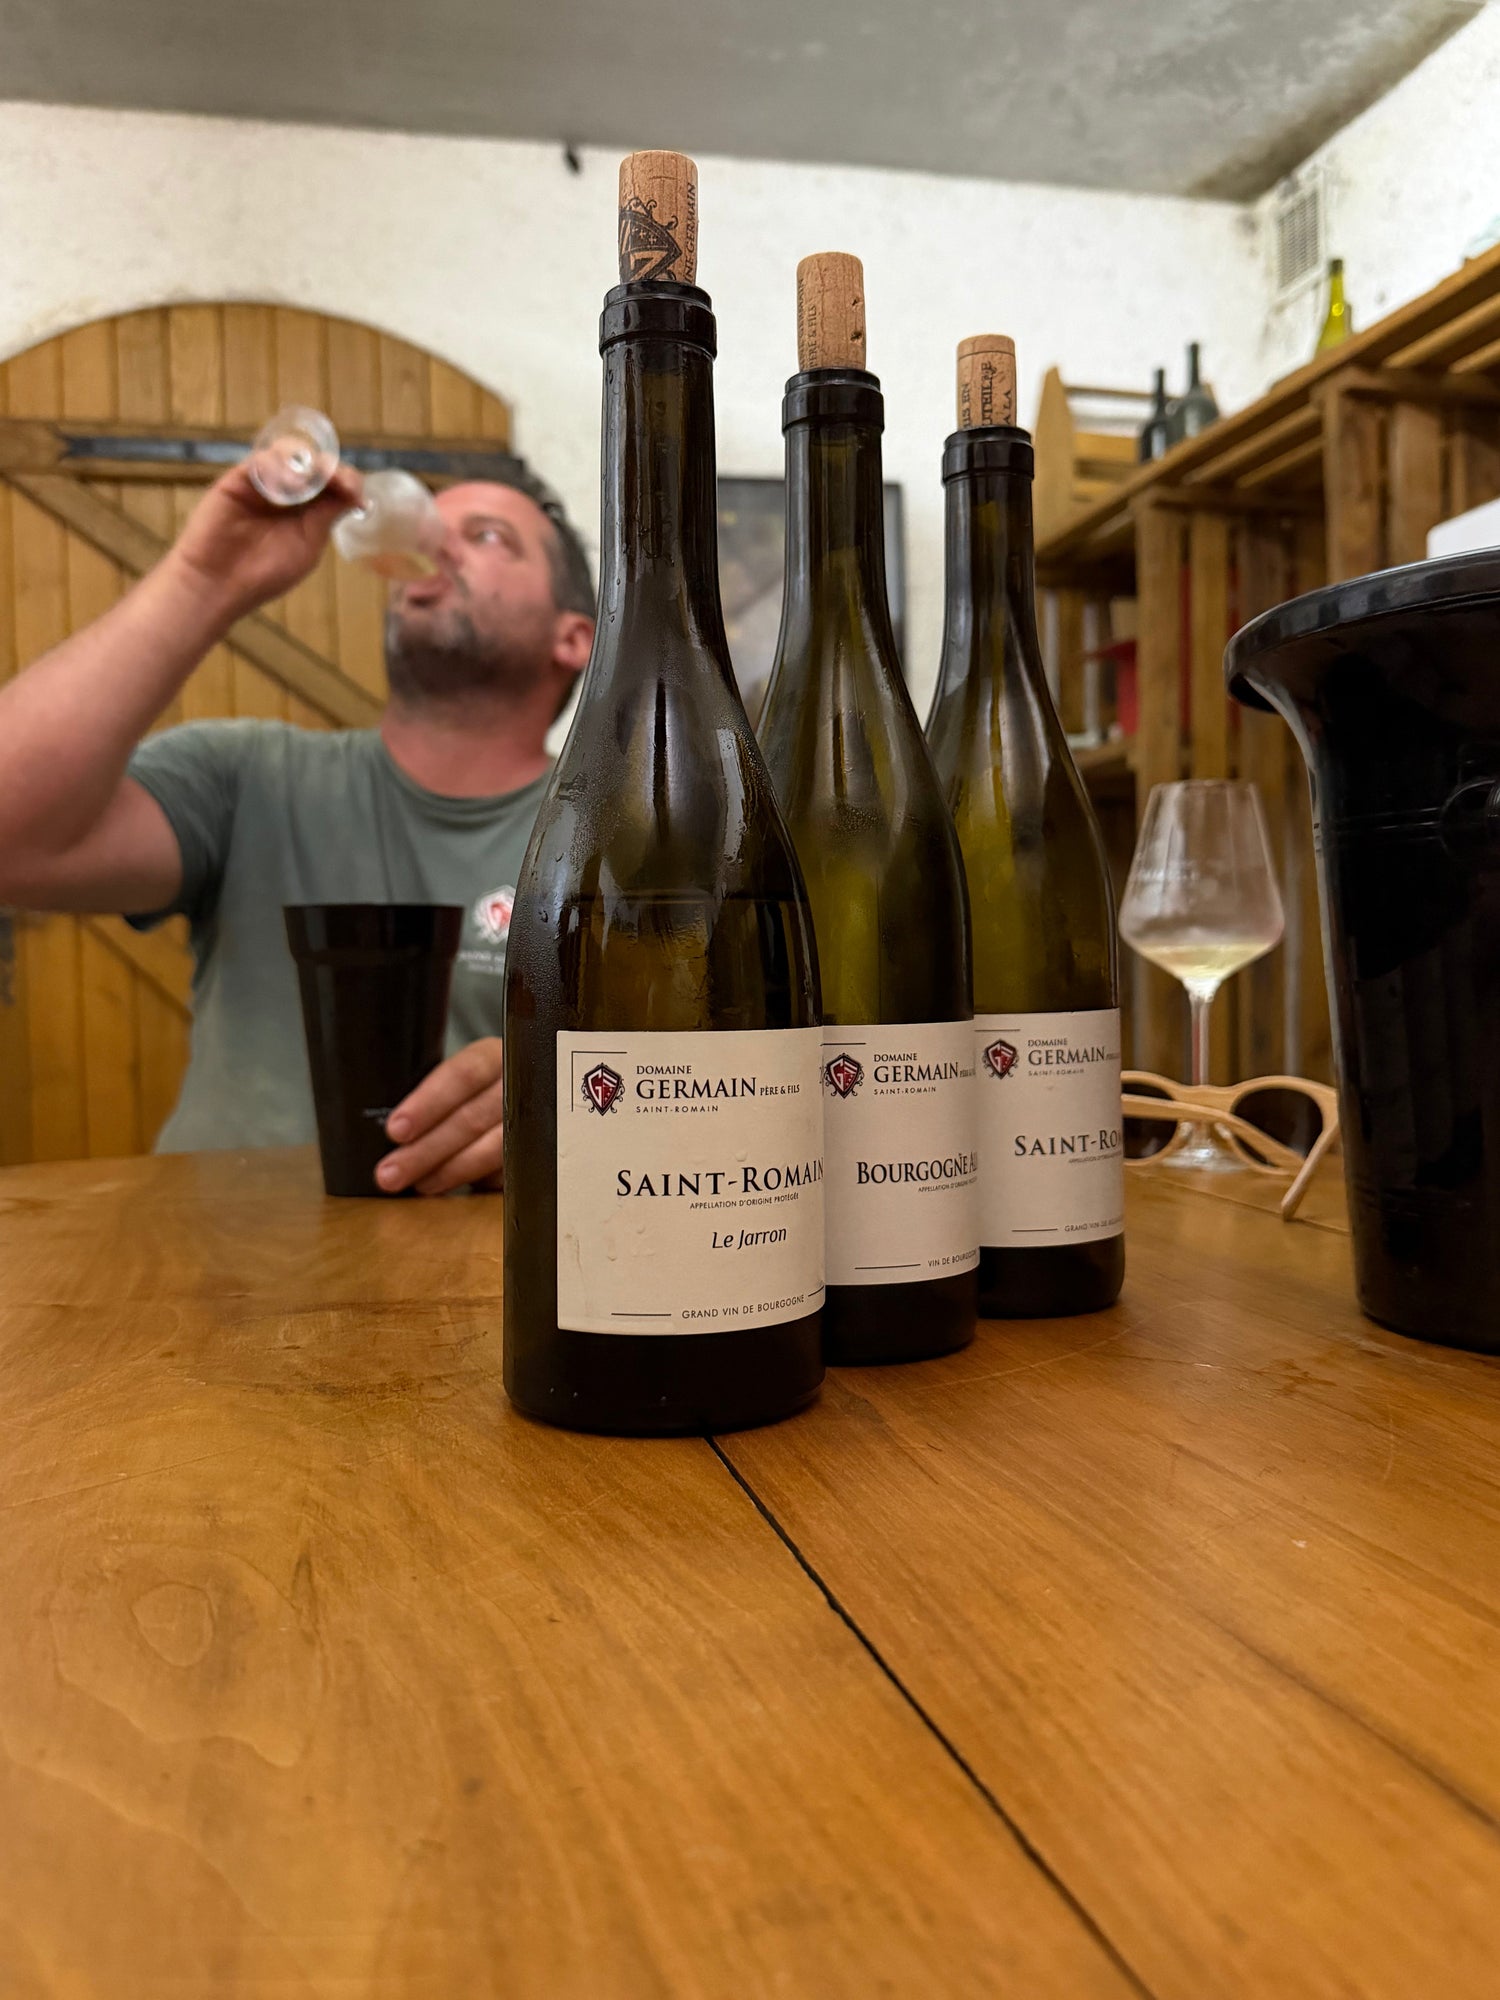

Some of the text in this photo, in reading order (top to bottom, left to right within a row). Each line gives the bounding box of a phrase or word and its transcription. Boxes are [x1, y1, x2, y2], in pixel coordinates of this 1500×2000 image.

[686, 182, 697, 253] GERMAIN
[1028, 1037, 1068, 1047] DOMAINE
[873, 1053, 918, 1062] DOMAINE
[1028, 1046, 1105, 1066] GERMAIN
[636, 1065, 692, 1075] DOMAINE
[873, 1061, 959, 1083] GERMAIN
[636, 1077, 756, 1100] GERMAIN
[780, 1085, 786, 1095] &
[787, 1084, 800, 1094] FILS
[873, 1086, 937, 1096] SAINT-ROMAIN
[636, 1105, 719, 1113] SAINT-ROMAIN
[617, 1157, 824, 1197] SAINT-ROMAIN
[857, 1152, 968, 1185] BOURGOGNE
[689, 1200, 737, 1210] APPELLATION
[739, 1197, 772, 1207] D'ORIGINE
[712, 1227, 787, 1251] Le Jarron
[927, 1259, 940, 1268] VIN
[682, 1293, 805, 1320] GRAND VIN DE BOURGOGNE
